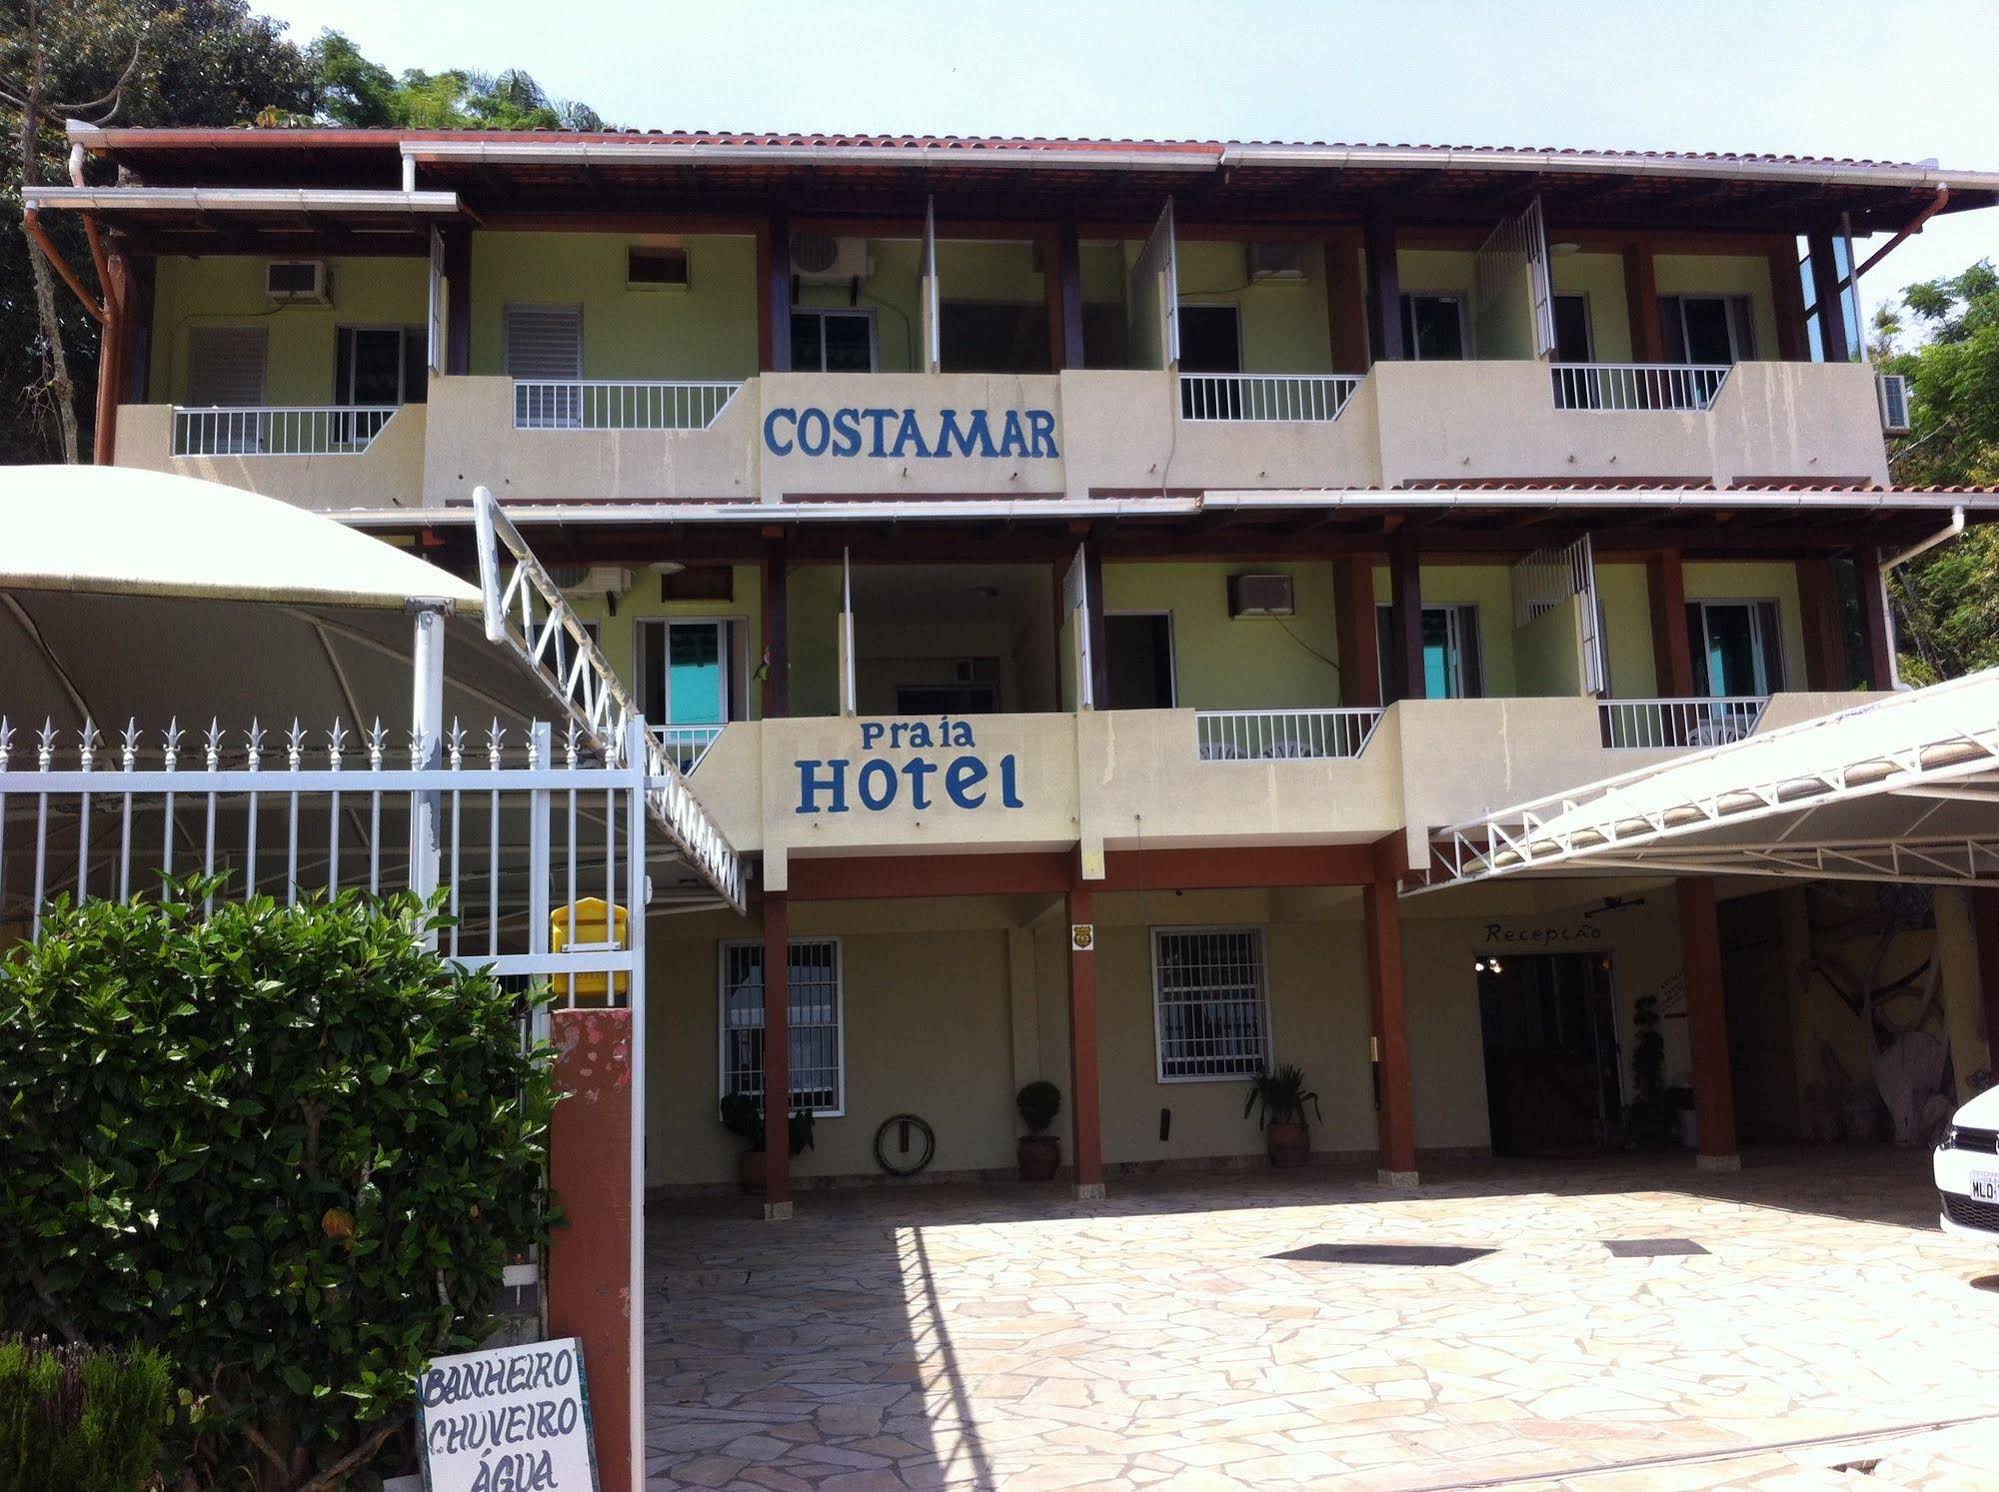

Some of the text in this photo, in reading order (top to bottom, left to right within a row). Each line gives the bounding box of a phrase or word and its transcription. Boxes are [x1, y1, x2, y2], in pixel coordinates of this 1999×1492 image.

[763, 407, 1061, 459] COSTAMAR
[860, 715, 976, 750] Praia
[794, 754, 1024, 814] Hotel
[423, 1349, 573, 1408] BANHEIRO
[428, 1397, 578, 1455] CHUVEIRO
[470, 1447, 559, 1492] ÁGUA
